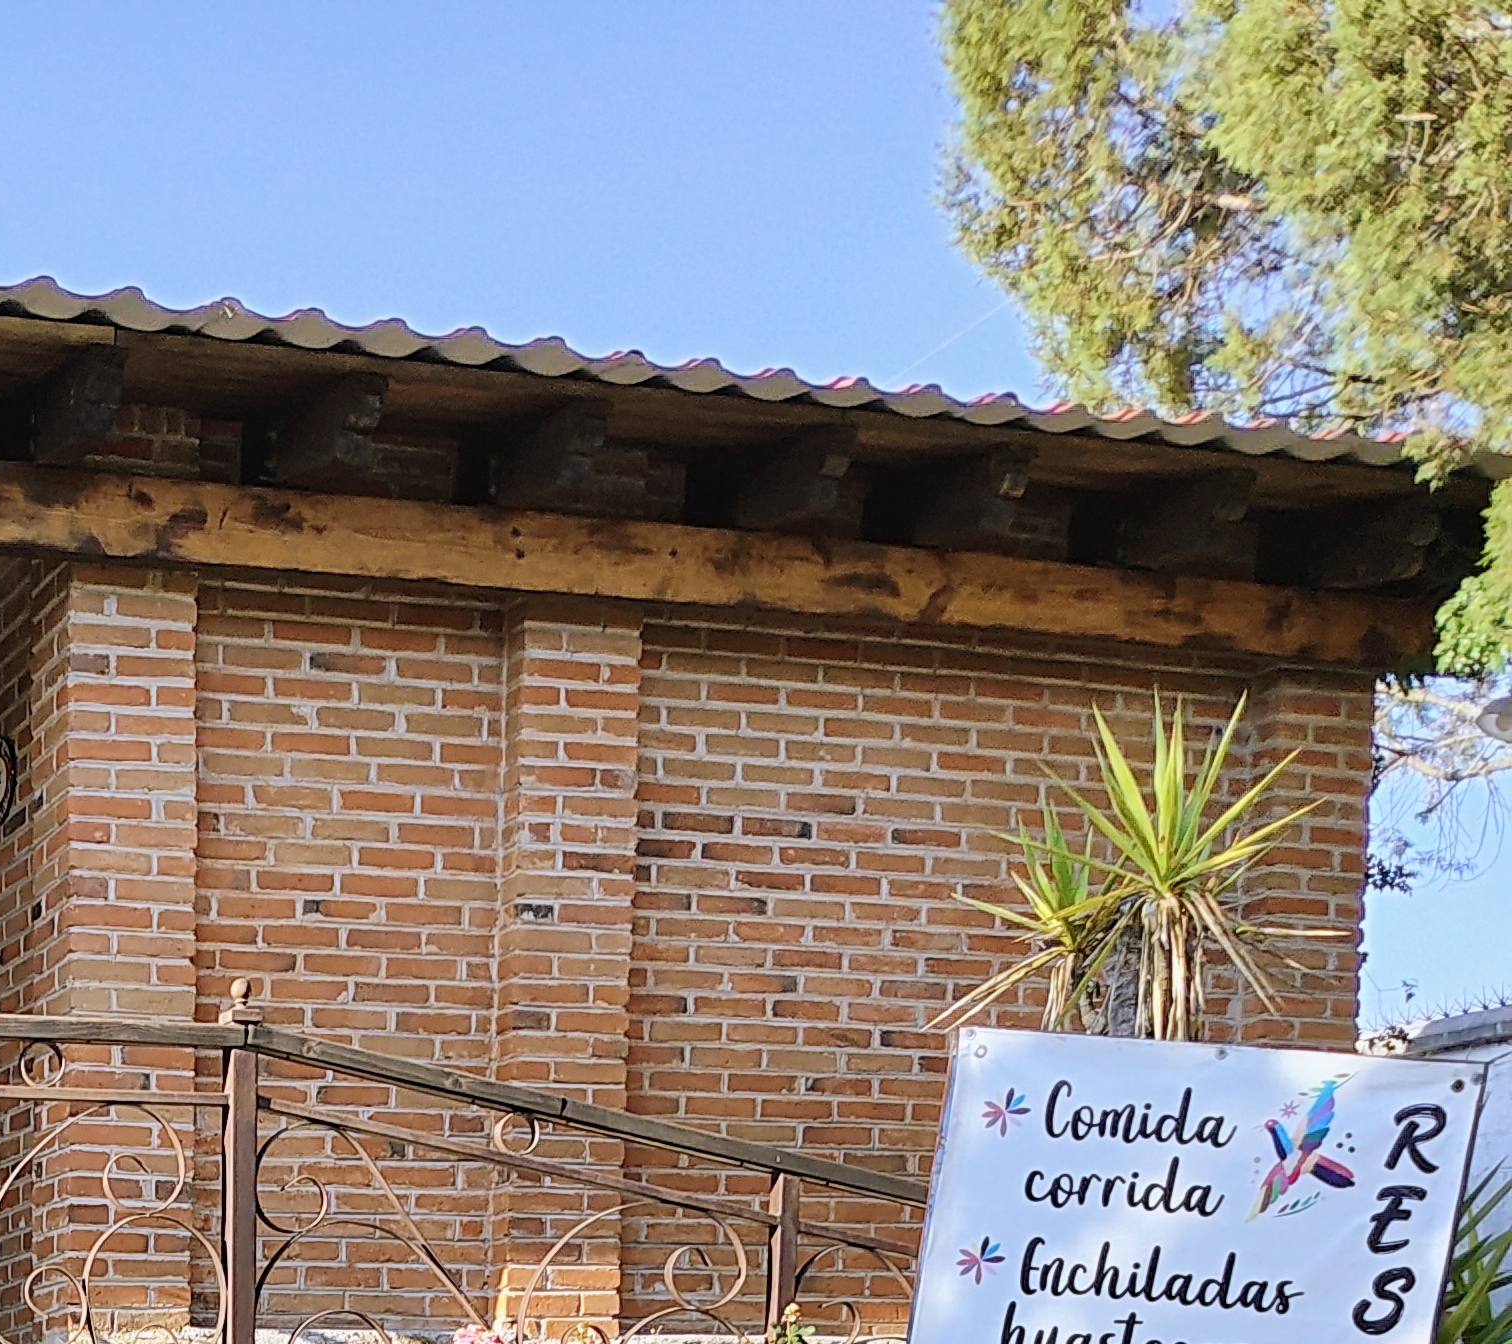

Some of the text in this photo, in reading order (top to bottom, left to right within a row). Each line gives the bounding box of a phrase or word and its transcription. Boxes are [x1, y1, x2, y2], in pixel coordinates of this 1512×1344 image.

[1045, 1079, 1238, 1148] Comida
[1024, 1156, 1225, 1217] corrida
[1020, 1236, 1305, 1315] Enchiladas
